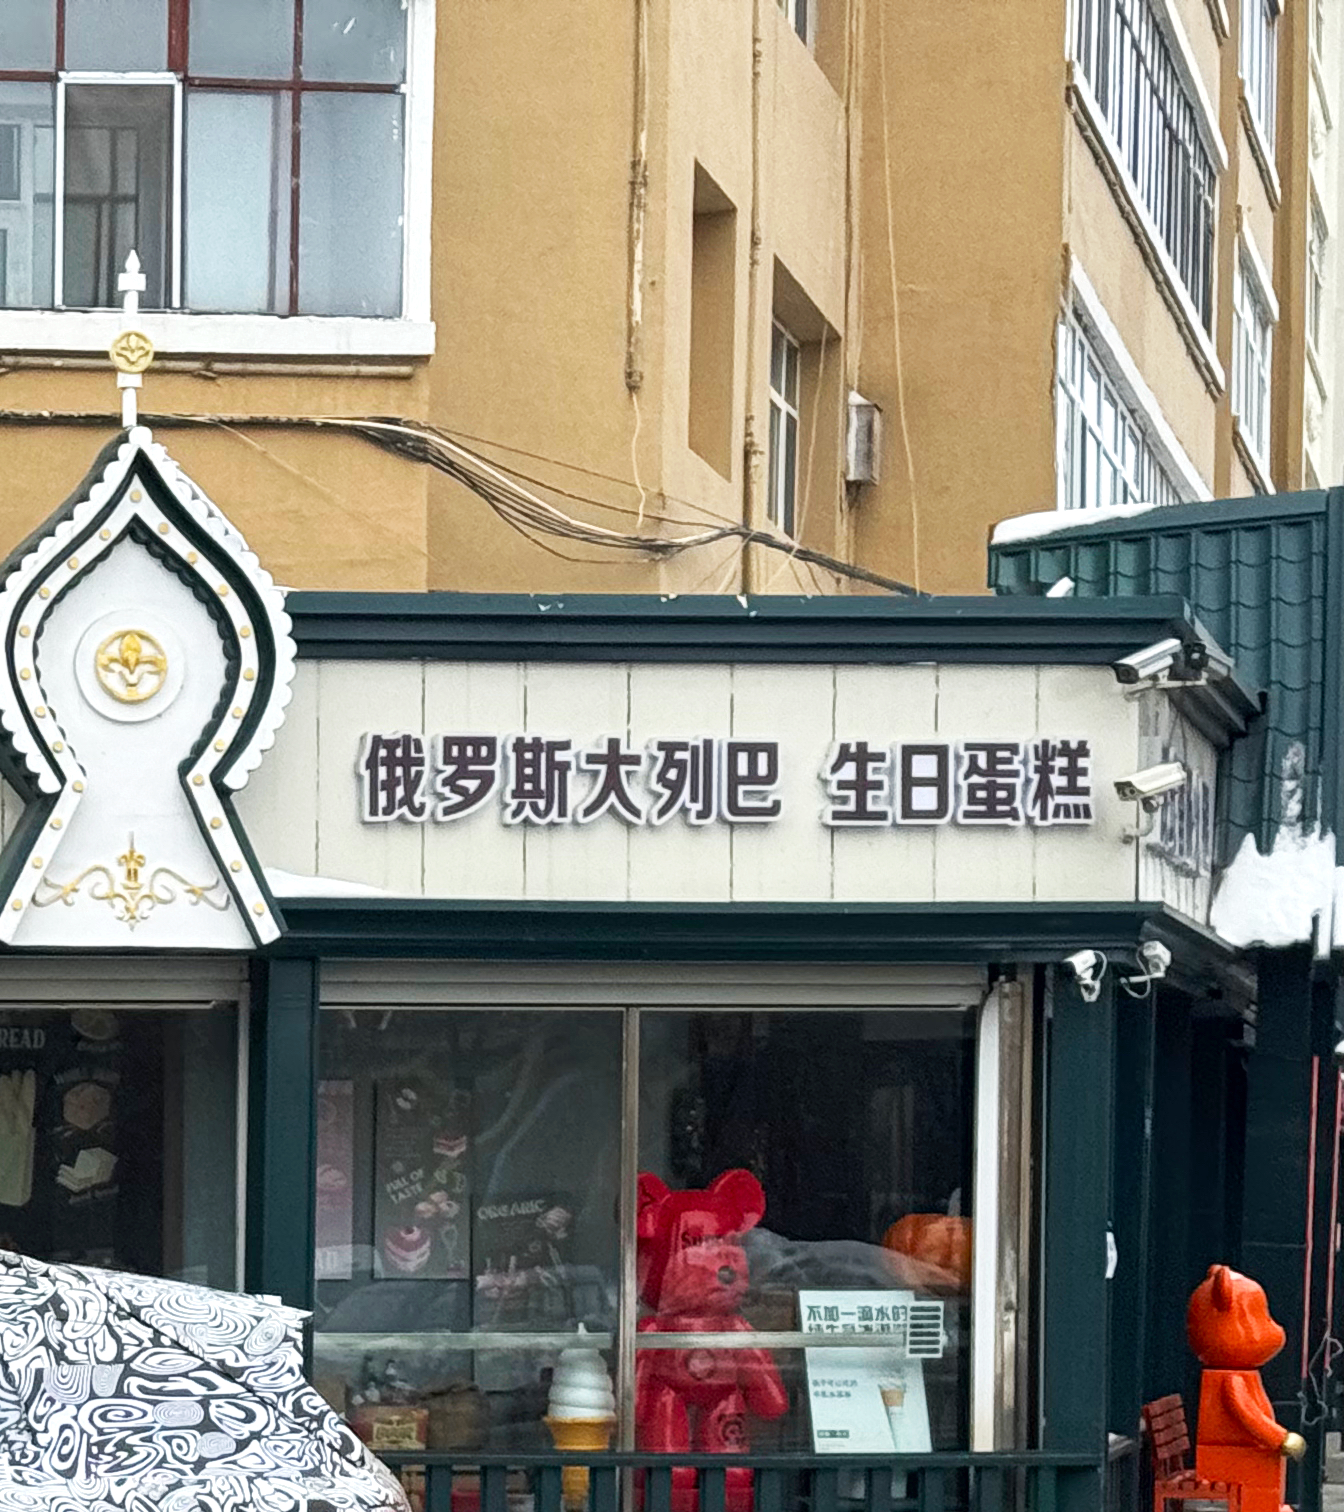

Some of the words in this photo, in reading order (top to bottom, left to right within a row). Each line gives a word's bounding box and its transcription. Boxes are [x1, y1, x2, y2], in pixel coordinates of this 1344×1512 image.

[364, 733, 783, 823] 俄罗斯大列巴
[829, 739, 1092, 823] 生日蛋糕
[806, 1305, 909, 1322] 不加一滴水的
